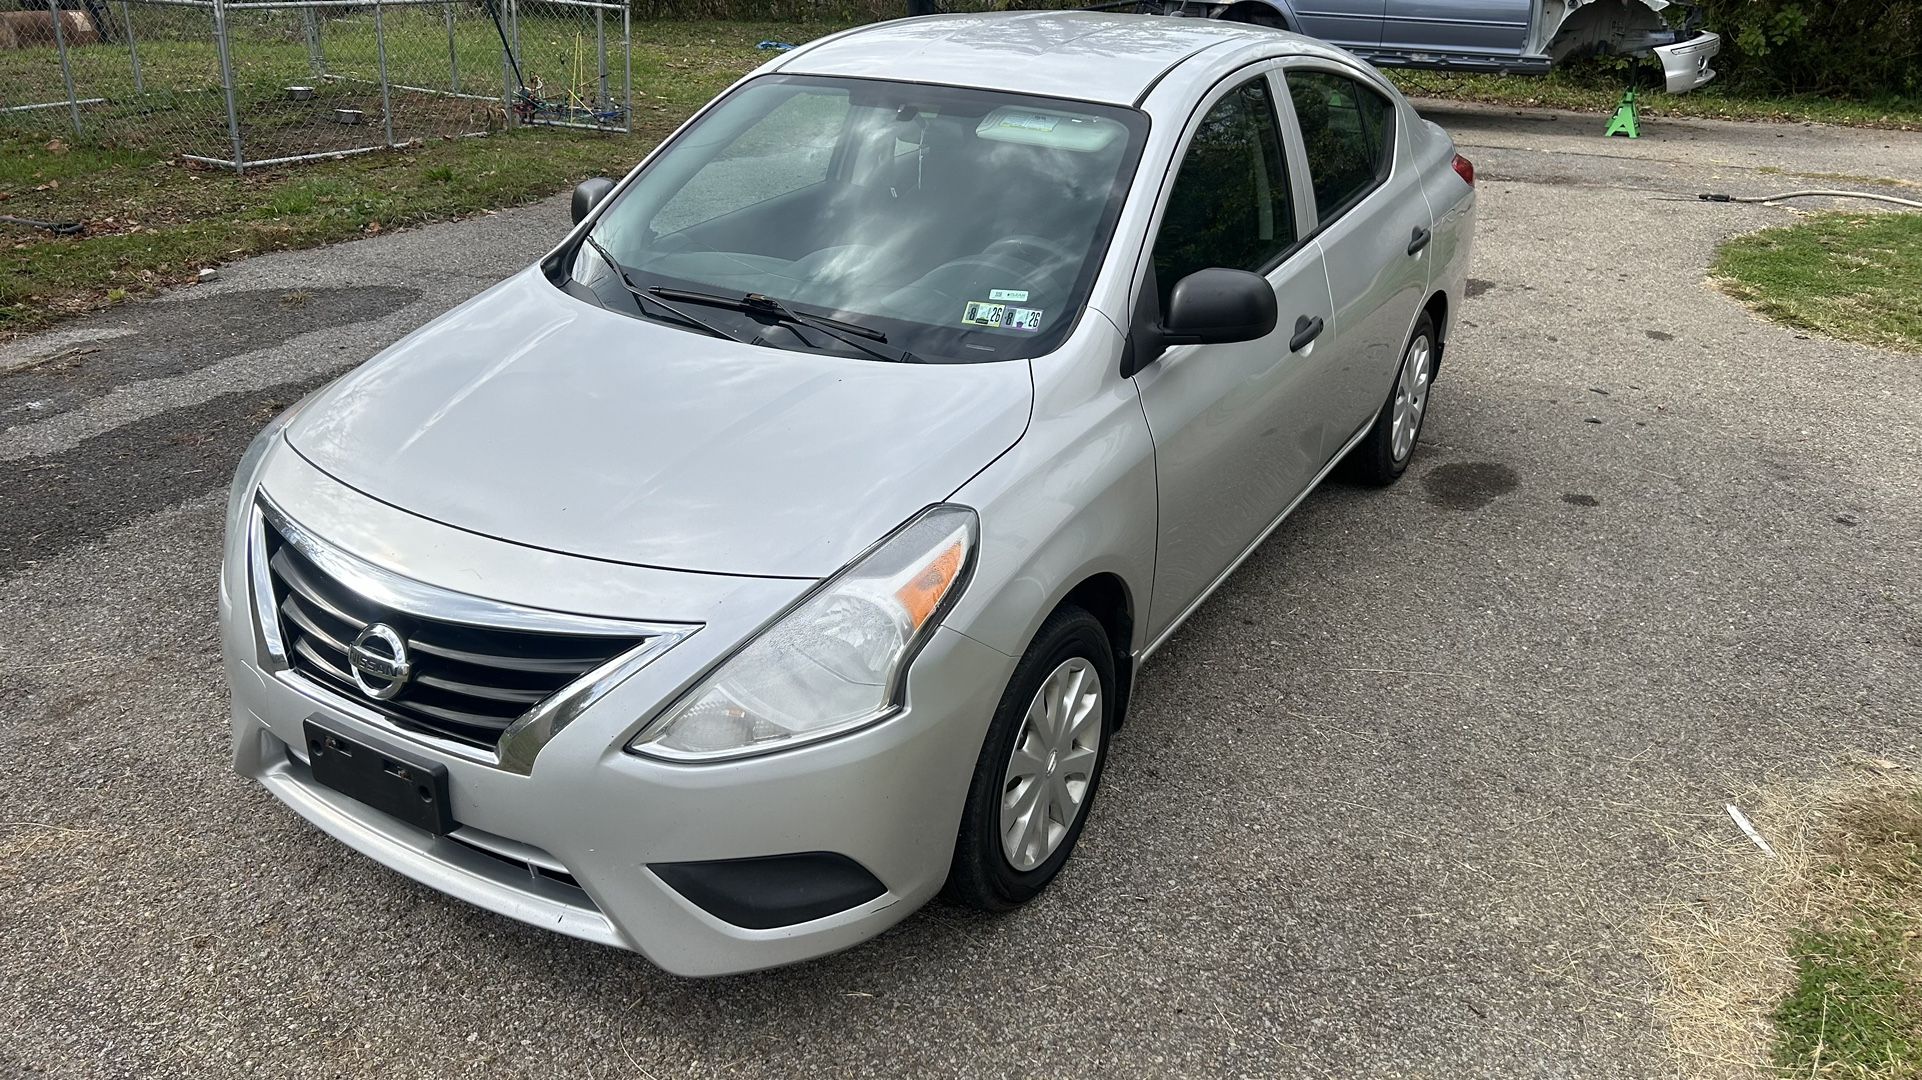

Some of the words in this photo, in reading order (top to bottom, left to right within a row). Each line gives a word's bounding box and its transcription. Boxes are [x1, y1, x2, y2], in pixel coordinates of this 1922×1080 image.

[969, 307, 977, 321] 8
[990, 307, 1003, 323] 26
[1005, 312, 1014, 326] 8
[1028, 311, 1041, 328] 26
[351, 649, 399, 677] NISSAN
